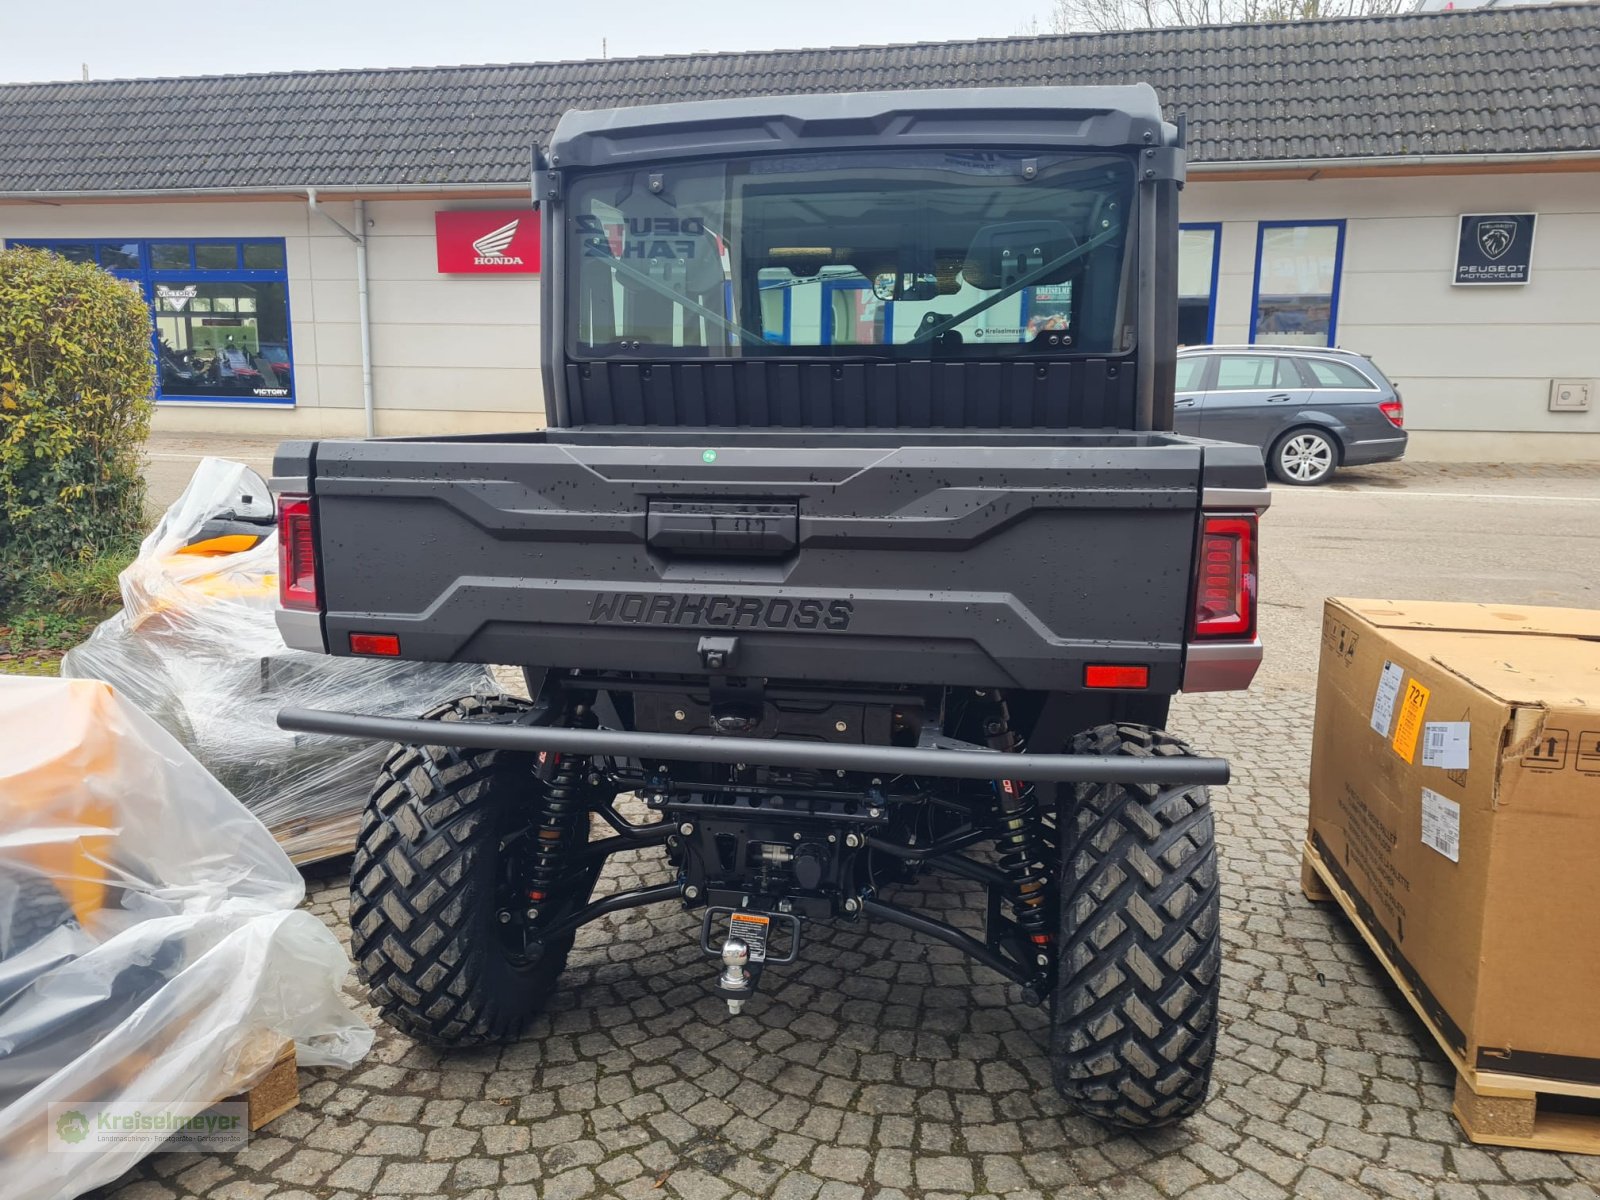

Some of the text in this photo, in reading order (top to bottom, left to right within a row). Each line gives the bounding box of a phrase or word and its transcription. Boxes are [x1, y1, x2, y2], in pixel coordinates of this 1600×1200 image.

[473, 256, 524, 265] HONDA
[588, 593, 855, 632] WORKCROSS
[1409, 684, 1425, 707] 721
